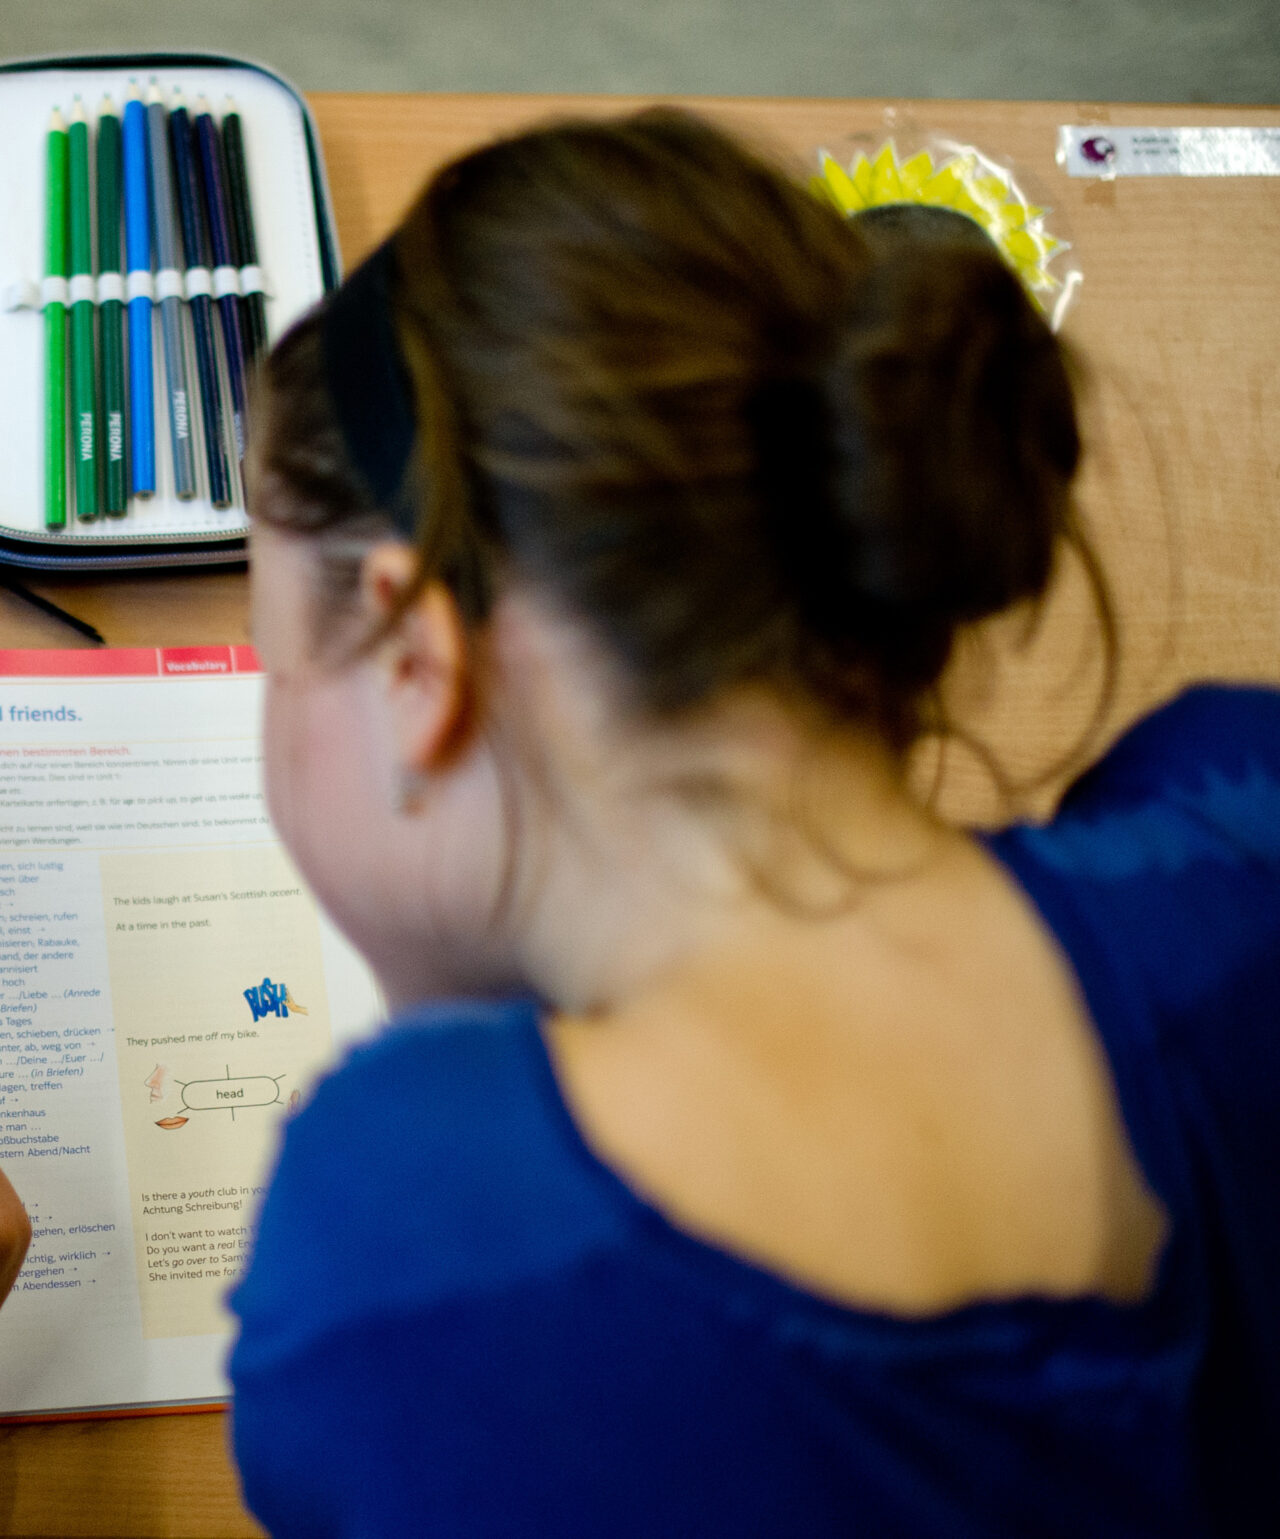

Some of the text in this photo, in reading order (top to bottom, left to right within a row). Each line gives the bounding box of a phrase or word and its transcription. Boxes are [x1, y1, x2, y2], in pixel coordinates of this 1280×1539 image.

[173, 391, 188, 439] PERONA
[81, 413, 93, 461] PERONA
[109, 413, 122, 461] PERONA
[167, 662, 226, 672] Vocabulary
[10, 705, 83, 722] friends.
[127, 1037, 148, 1047] They
[151, 1035, 185, 1045] pushed
[188, 1034, 203, 1042] me
[220, 1032, 234, 1041] my
[216, 1089, 244, 1099] head
[6, 1123, 27, 1131] man
[142, 1193, 150, 1201] Is
[152, 1192, 177, 1201] there
[188, 1188, 214, 1200] youth
[218, 1188, 237, 1196] club
[143, 1200, 242, 1214] Achtung Schreibung!
[69, 1223, 115, 1233] erlöschen
[151, 1230, 176, 1240] don't
[179, 1230, 202, 1239] want
[205, 1229, 214, 1237] to
[218, 1227, 246, 1236] watch
[59, 1250, 96, 1261] wirklich
[147, 1246, 160, 1255] Do
[162, 1246, 179, 1256] you
[182, 1243, 206, 1252] want
[148, 1255, 219, 1268] Let's go over to
[149, 1272, 167, 1281] She
[170, 1270, 202, 1279] invited
[22, 1279, 81, 1290] Abendessen
